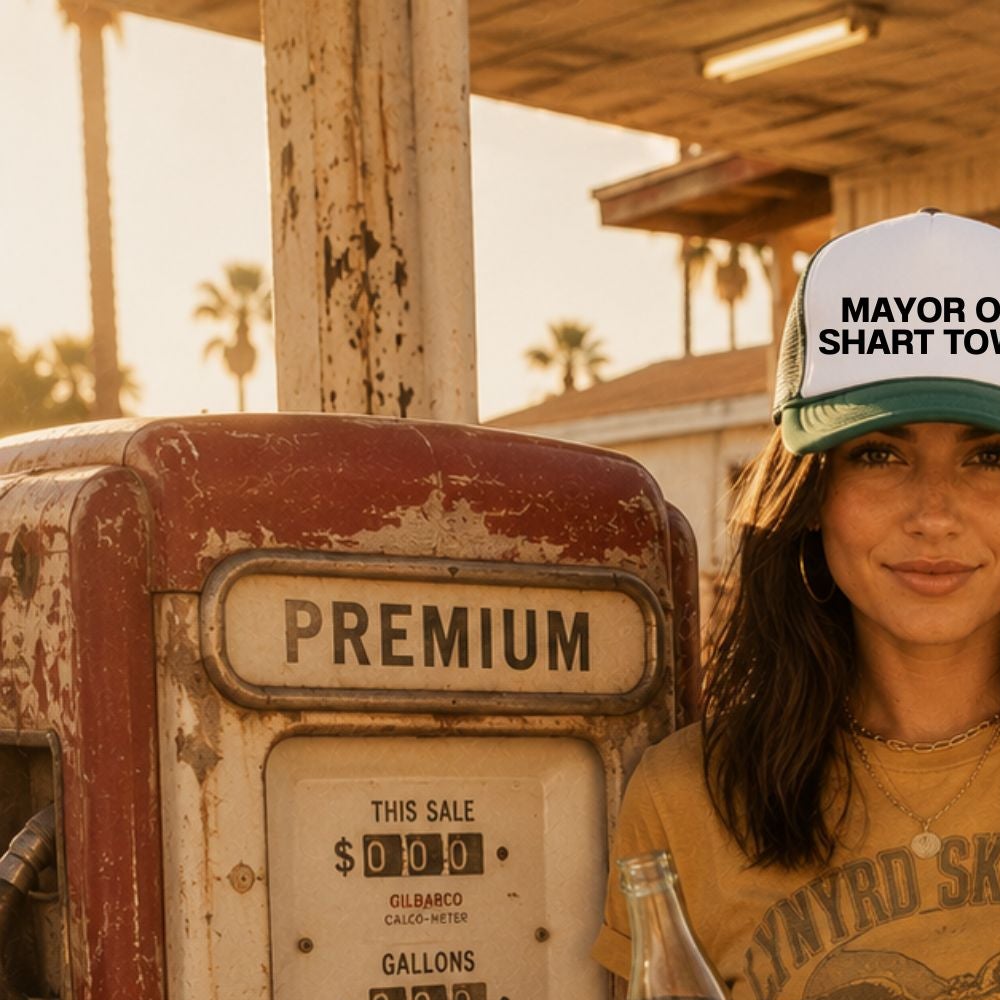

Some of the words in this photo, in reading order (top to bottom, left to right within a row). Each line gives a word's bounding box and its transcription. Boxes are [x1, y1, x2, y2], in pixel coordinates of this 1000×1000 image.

[841, 296, 966, 323] MAYOR
[818, 328, 935, 355] SHART
[284, 598, 591, 672] PREMIUM
[371, 799, 418, 823] THIS
[426, 799, 476, 823] SALE
[381, 949, 476, 976] GALLONS
